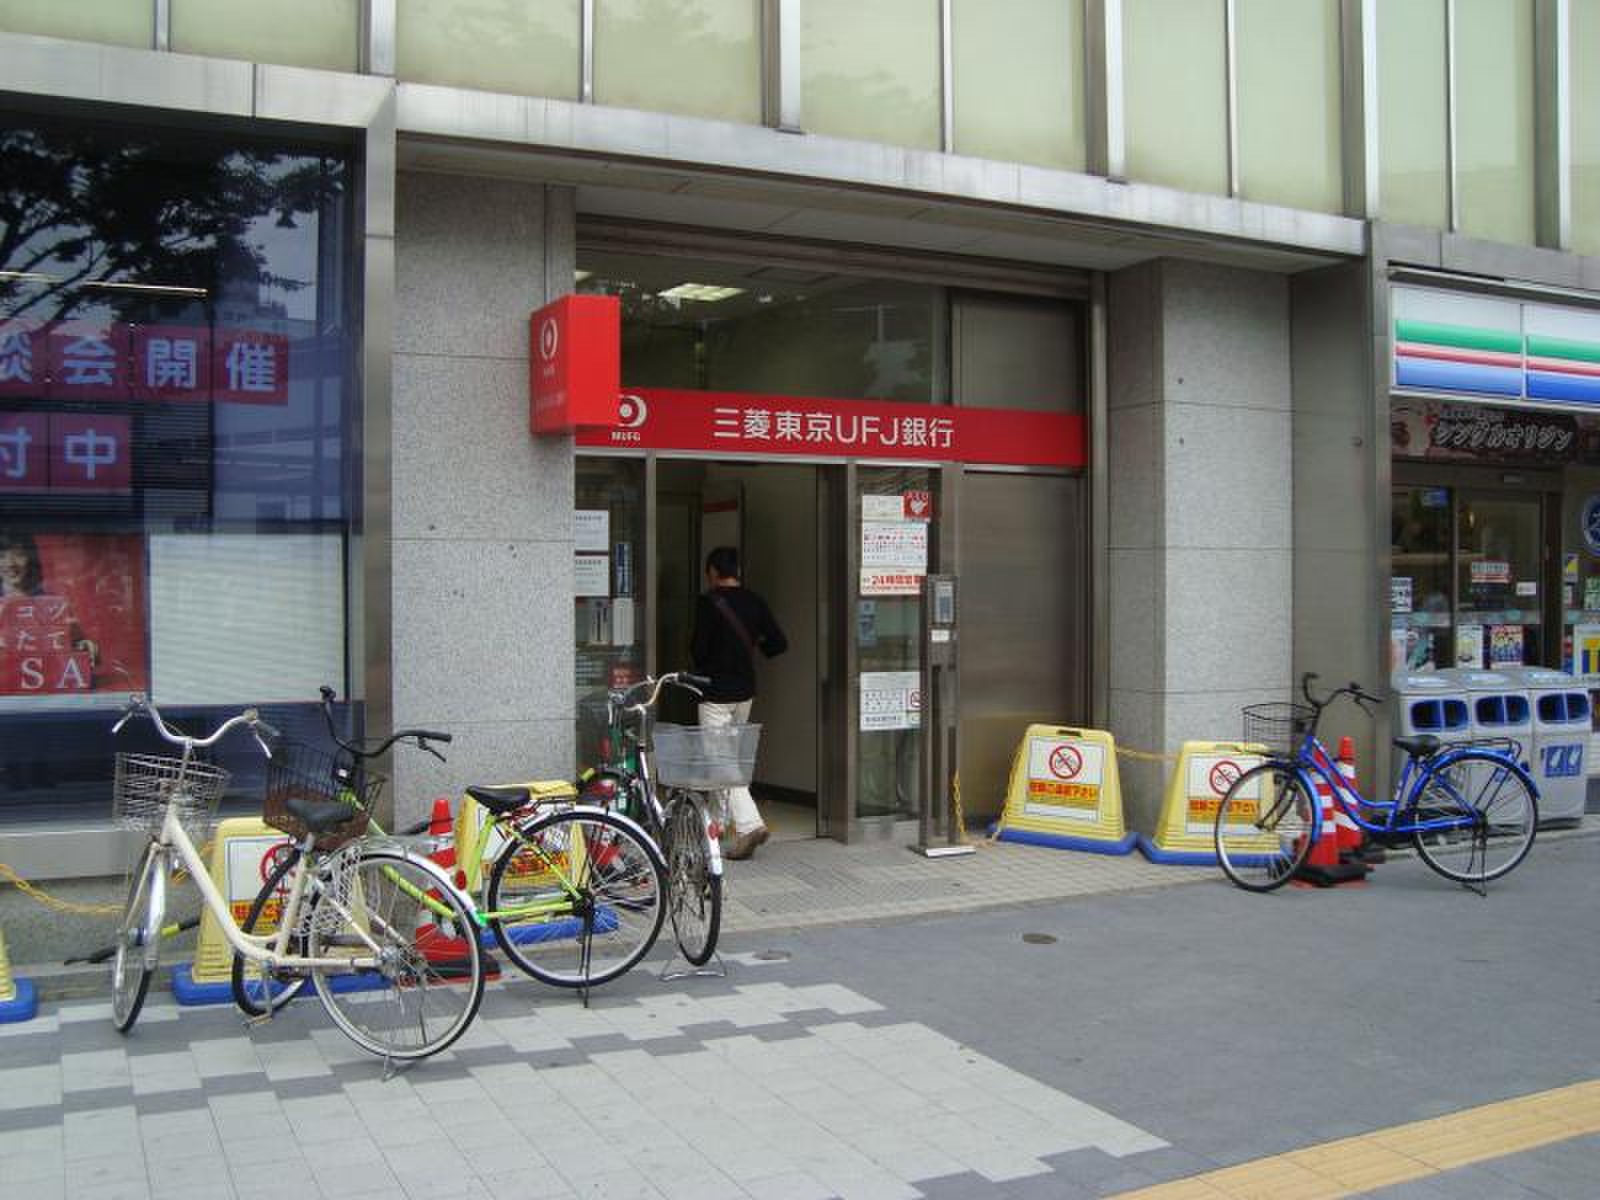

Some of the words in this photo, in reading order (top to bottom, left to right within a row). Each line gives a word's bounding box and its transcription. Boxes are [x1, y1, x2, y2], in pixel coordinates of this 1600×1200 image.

[714, 408, 954, 448] 三菱東京UFJ銀行
